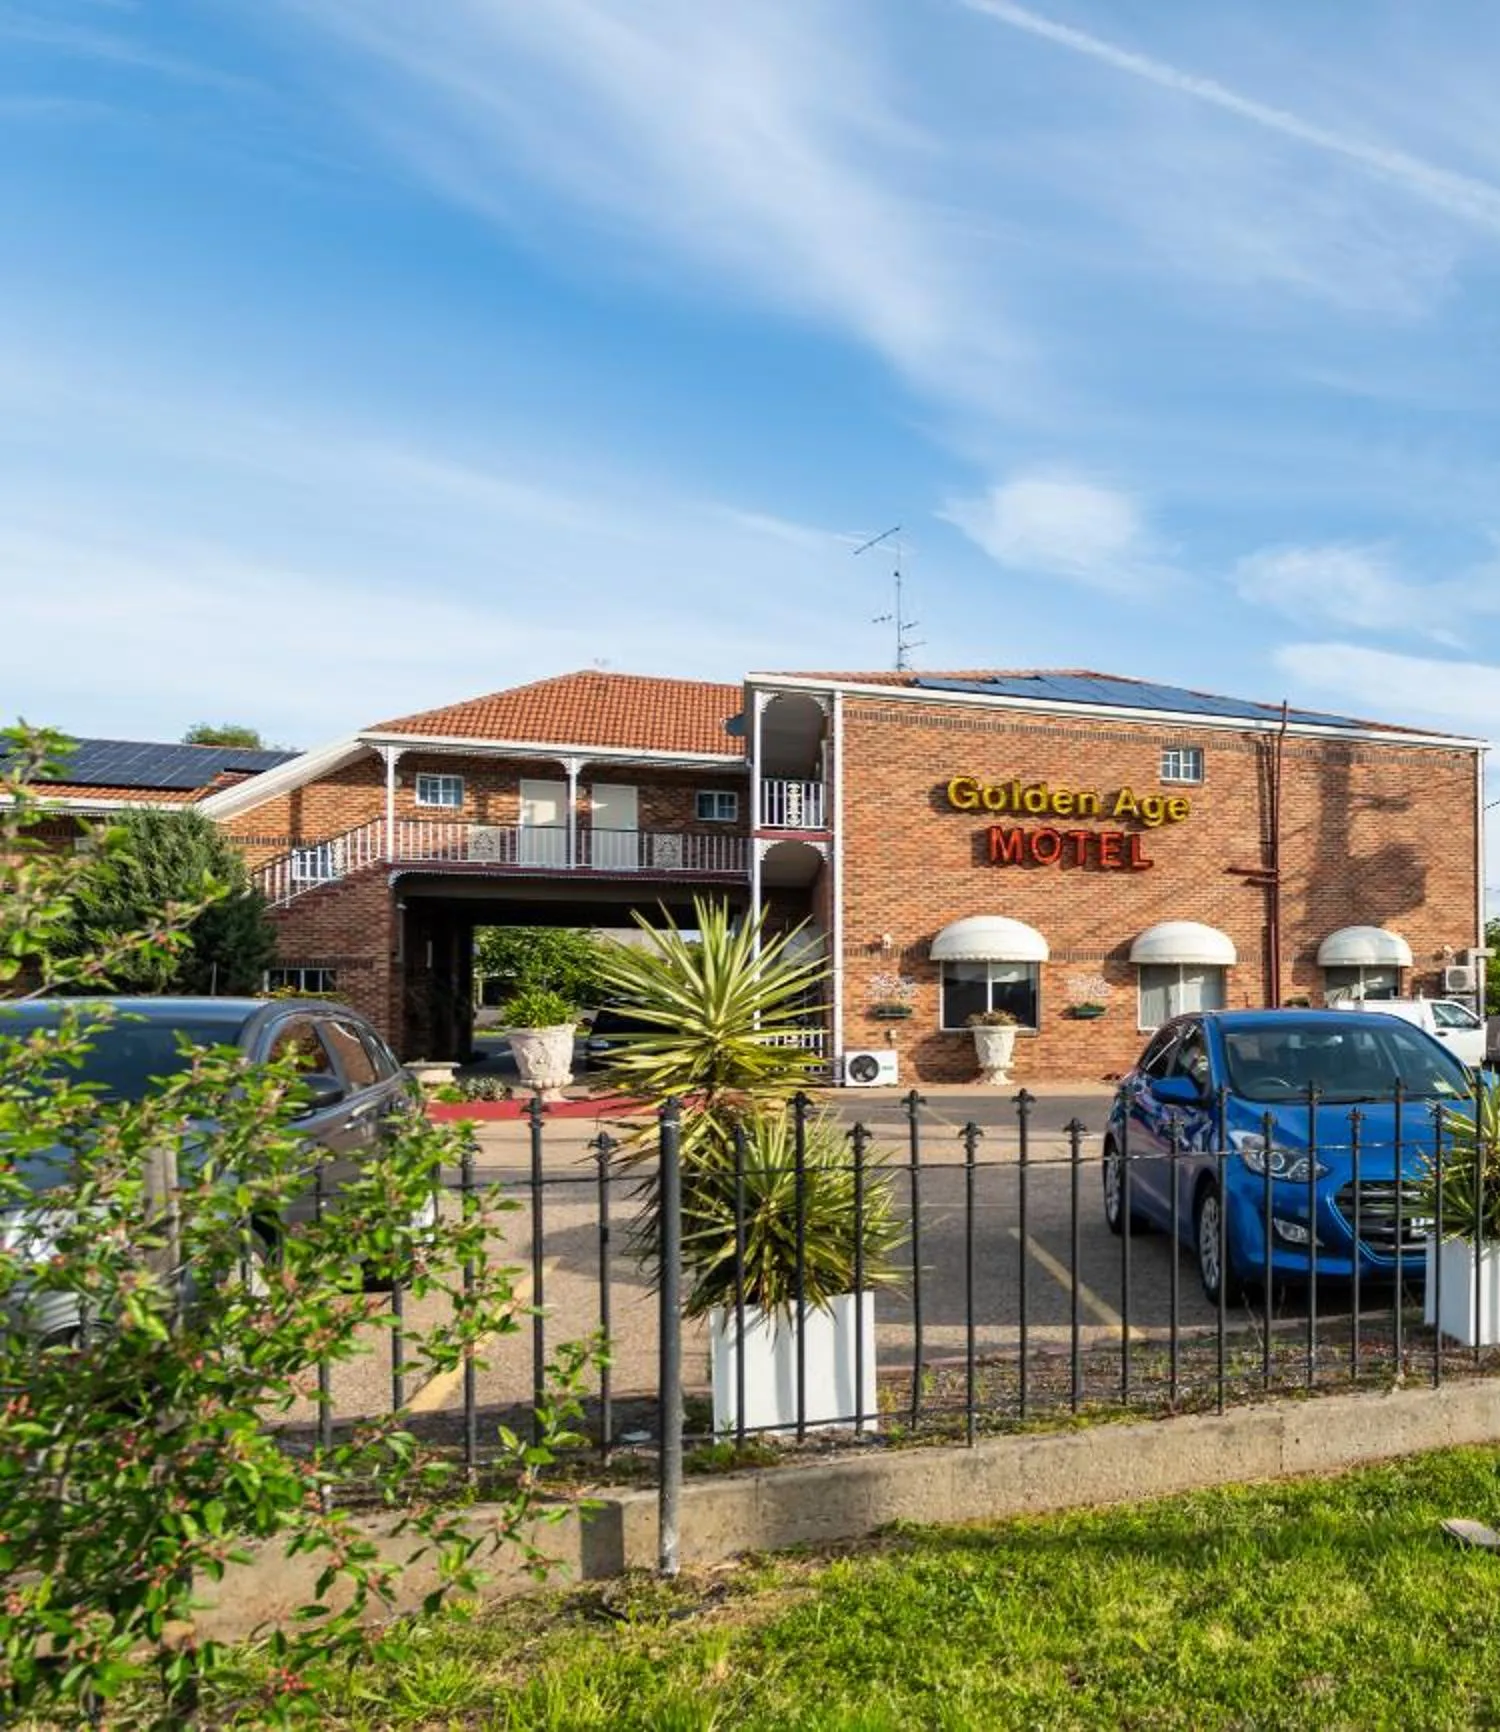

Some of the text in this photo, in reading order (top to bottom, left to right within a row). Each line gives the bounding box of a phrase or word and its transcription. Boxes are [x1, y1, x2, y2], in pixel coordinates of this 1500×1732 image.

[947, 775, 1191, 827] Golden Age
[986, 825, 1154, 870] MOTEL
